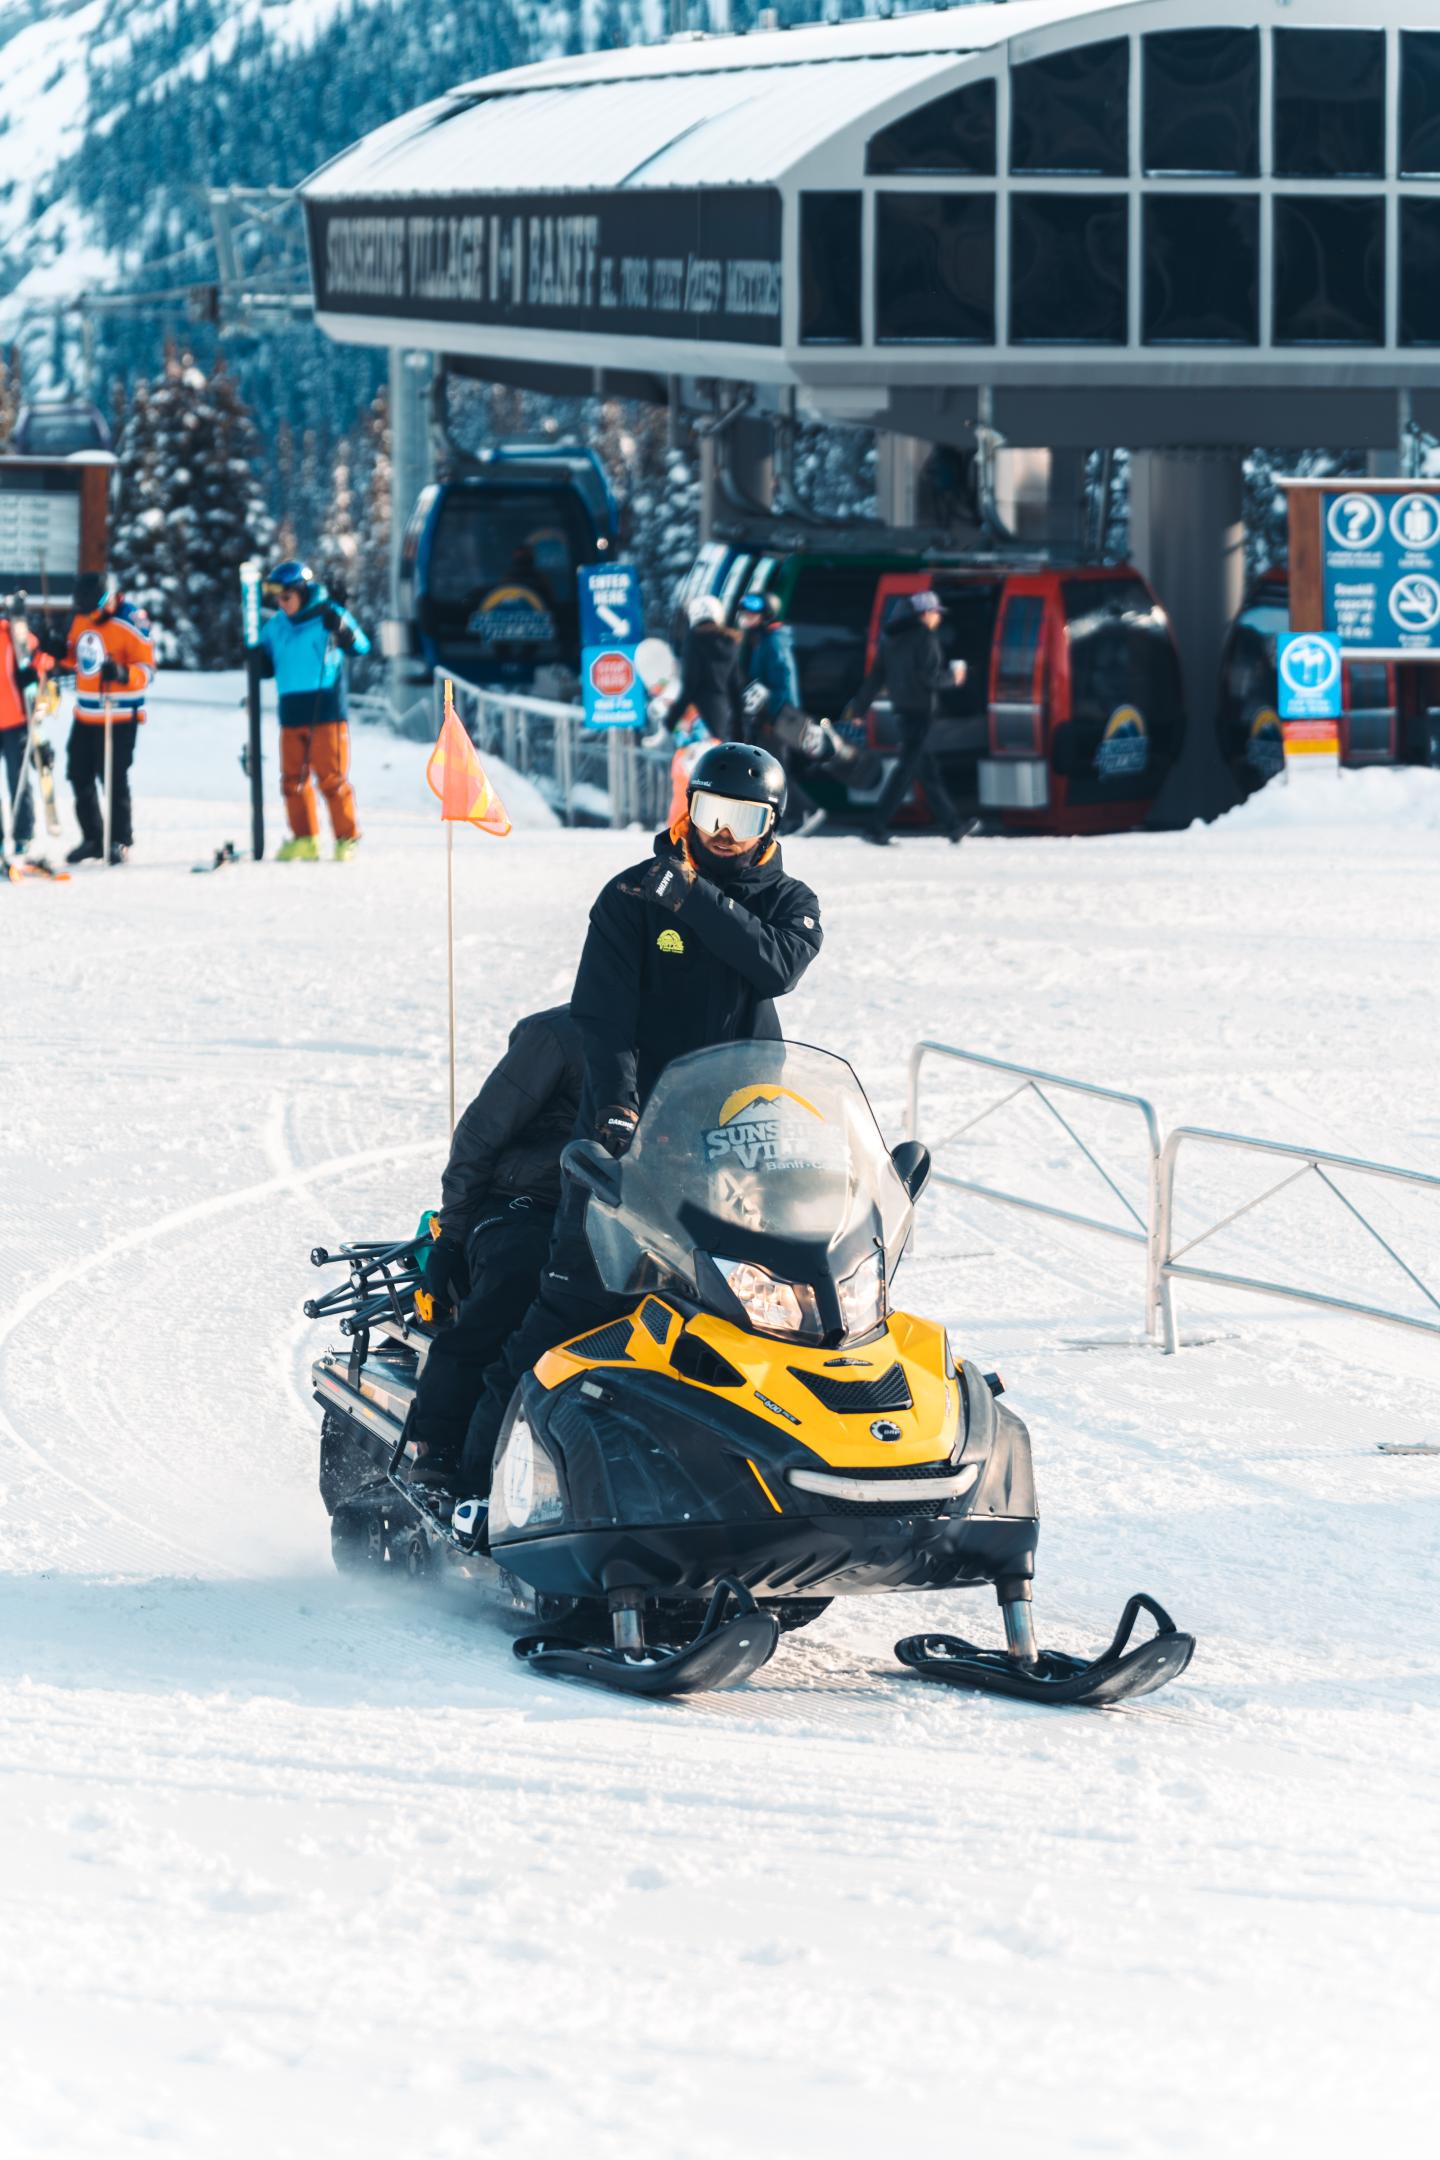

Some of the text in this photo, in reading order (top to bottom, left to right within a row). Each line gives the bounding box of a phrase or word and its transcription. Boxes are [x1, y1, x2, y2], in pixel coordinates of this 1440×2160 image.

[527, 215, 599, 306] BANFF
[588, 573, 631, 591] ENTER
[593, 591, 627, 606] HERE
[764, 1399, 782, 1414] 600
